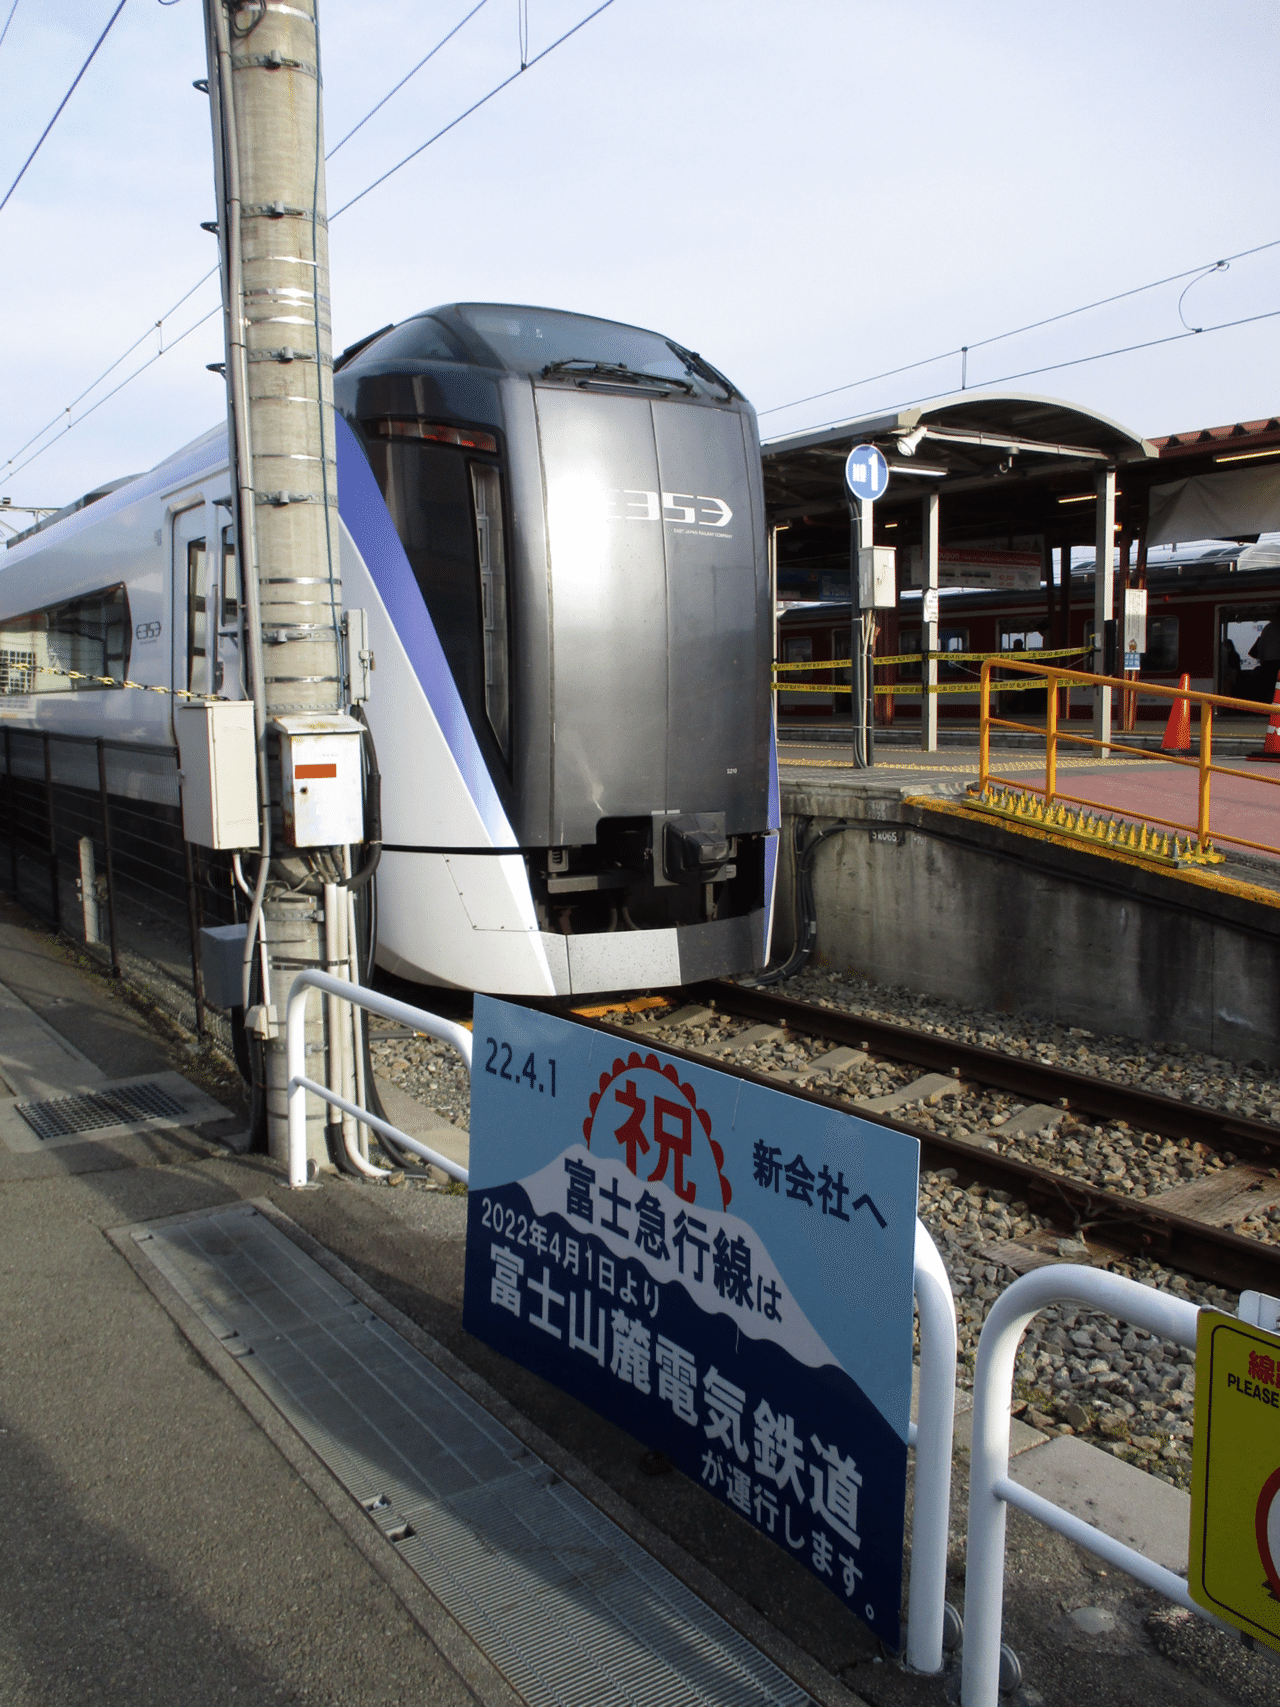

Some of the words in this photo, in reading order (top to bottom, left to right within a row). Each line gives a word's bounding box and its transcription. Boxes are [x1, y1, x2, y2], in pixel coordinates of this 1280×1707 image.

[136, 621, 162, 640] E353
[485, 1037, 556, 1098] 22.4.1
[613, 1078, 697, 1205] 祝
[752, 1138, 888, 1230] 新会社へ
[481, 1197, 659, 1318] 2022年4月1日より
[564, 1157, 783, 1323] 富士急行線は
[490, 1241, 863, 1551] 富士山麓電気鉄道
[1227, 1372, 1280, 1409] PLEASE
[1248, 1350, 1280, 1389] 線
[701, 1448, 875, 1621] が運行します。
